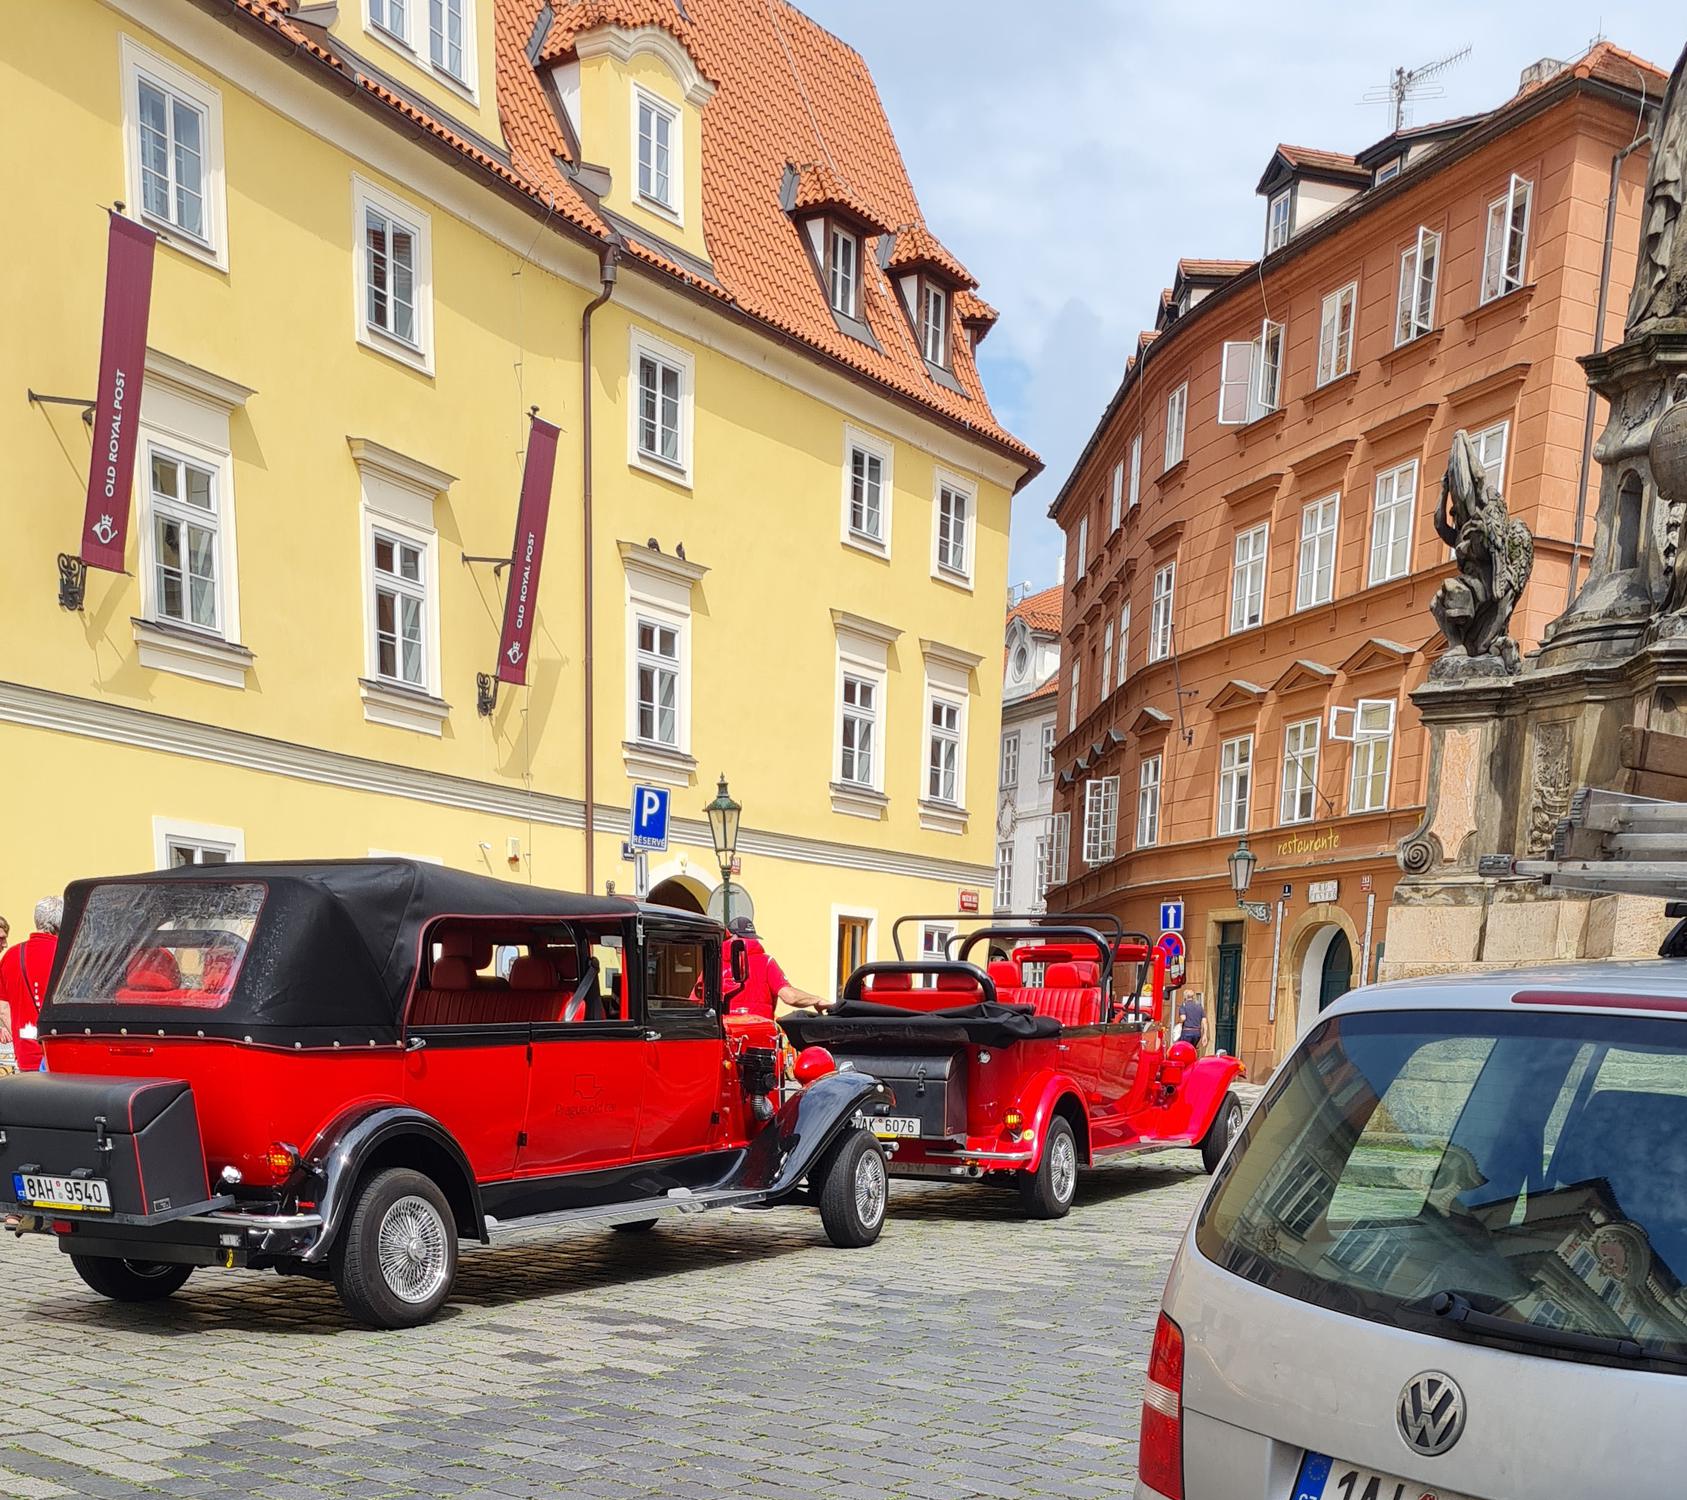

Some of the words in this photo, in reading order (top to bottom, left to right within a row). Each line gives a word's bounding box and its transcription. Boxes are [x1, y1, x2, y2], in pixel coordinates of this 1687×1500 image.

[113, 369, 125, 409] POST
[108, 414, 122, 462] ROYAL
[105, 466, 116, 497] OLD
[525, 532, 535, 562] POST
[520, 565, 531, 602] ROYAL
[516, 605, 525, 628] OLD
[642, 791, 660, 827] P
[1277, 827, 1340, 855] restaurante
[885, 1120, 914, 1133] 6076
[27, 1178, 55, 1200] 8AH
[64, 1181, 102, 1203] 9540
